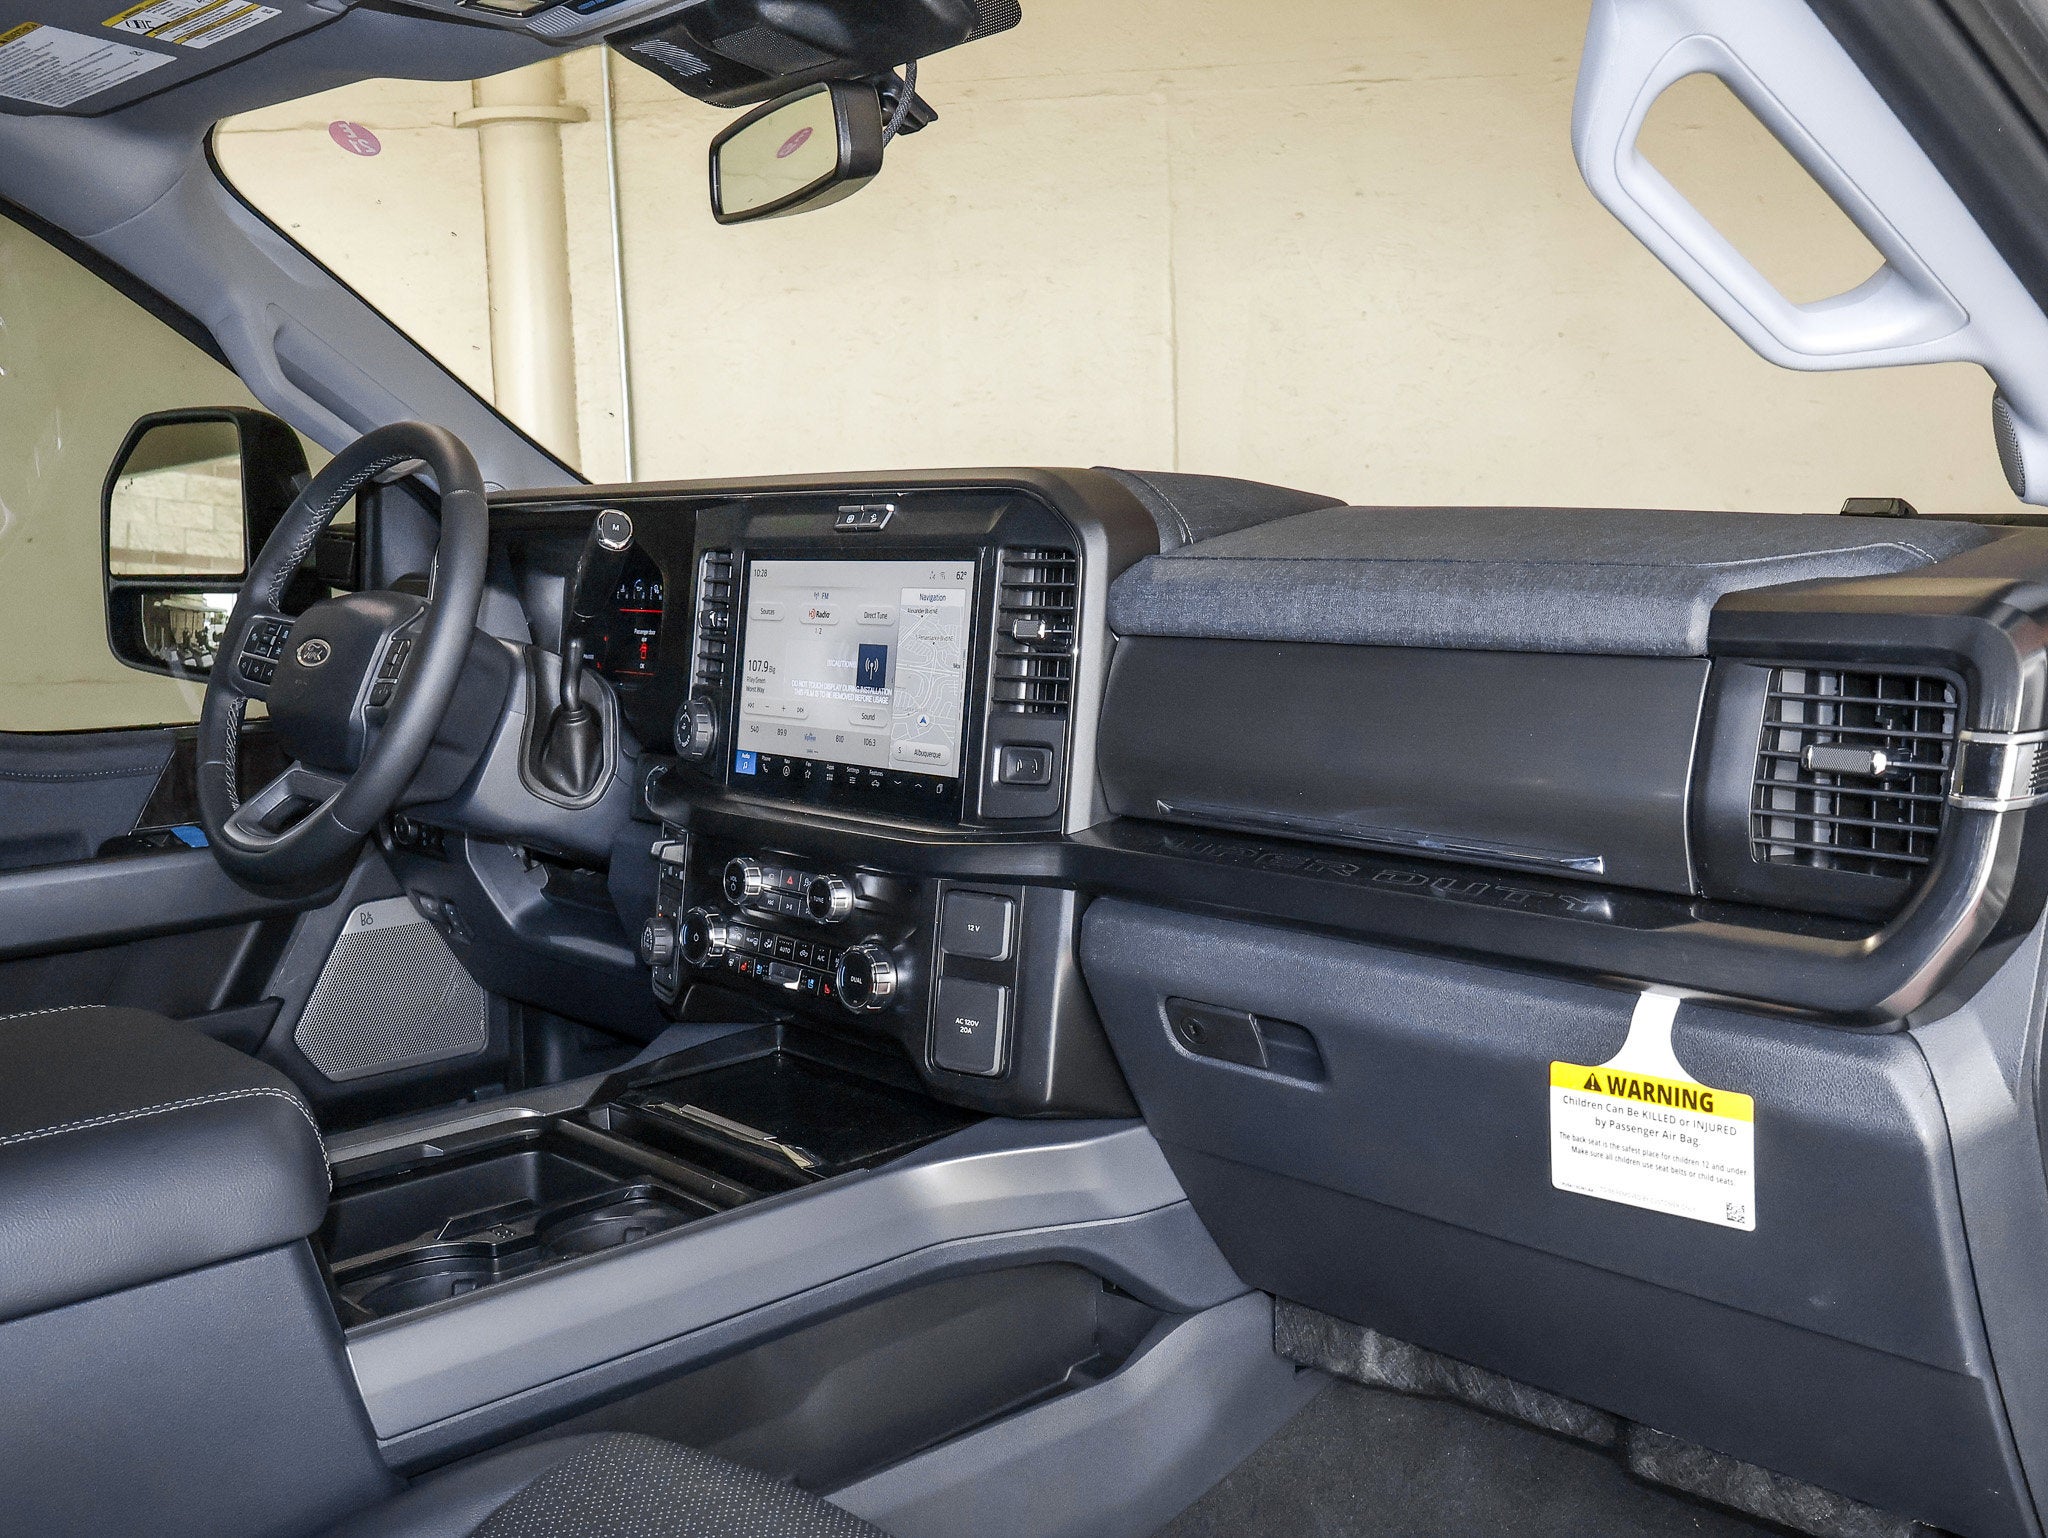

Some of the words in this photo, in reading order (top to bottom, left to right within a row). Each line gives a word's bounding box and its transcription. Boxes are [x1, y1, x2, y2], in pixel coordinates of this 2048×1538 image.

[754, 569, 768, 578] 10:28
[821, 592, 829, 600] FM
[919, 593, 947, 602] Navigation
[760, 607, 775, 616] Sources
[863, 611, 876, 619] Direct
[877, 612, 888, 620] Tune
[748, 659, 769, 673] 107.9
[799, 680, 808, 688] NOT
[809, 681, 824, 690] TOUCH
[824, 682, 842, 692] DISPLAY
[842, 684, 860, 693] DURING
[860, 686, 892, 695] INSTALLATION
[804, 689, 814, 697] FILM
[819, 690, 826, 698] TO
[833, 692, 854, 700] REMOVED
[855, 694, 873, 702] BEFORE
[873, 697, 888, 705] USAGE
[861, 712, 876, 720] Sound
[750, 725, 760, 733] 540
[864, 738, 876, 746] 106.3
[914, 749, 942, 759] Albuquerque
[846, 766, 860, 774] Settings
[967, 924, 975, 932] 12
[779, 946, 791, 954] AUTO
[850, 976, 862, 985] DUAL
[955, 1017, 964, 1025] AC
[964, 1019, 980, 1028] 120V
[960, 1027, 973, 1035] 20A
[1607, 1075, 1713, 1113] WARNING
[1563, 1095, 1603, 1110] Children
[1606, 1103, 1624, 1114] Can
[1627, 1107, 1639, 1117] Be
[1642, 1110, 1676, 1124] KILLED
[1680, 1119, 1689, 1127] or
[1694, 1120, 1736, 1136] INJURED
[1595, 1117, 1607, 1129] by
[1609, 1120, 1659, 1138] Passenger
[1662, 1130, 1676, 1140] Air
[1680, 1133, 1701, 1148] Bag.
[1560, 1131, 1570, 1140] The
[1572, 1134, 1586, 1143] back
[1588, 1138, 1600, 1146] seat
[1610, 1142, 1620, 1150] the
[1622, 1144, 1641, 1155] safest
[1642, 1149, 1659, 1159] place
[1661, 1152, 1670, 1160] for
[1673, 1154, 1700, 1166] children
[1702, 1160, 1710, 1169] 12
[1712, 1163, 1724, 1172] and
[1571, 1146, 1589, 1156] Make
[1590, 1151, 1603, 1159] sure
[1605, 1152, 1613, 1160] all
[1615, 1154, 1640, 1166] children
[1642, 1161, 1653, 1169] use
[1656, 1164, 1669, 1173] seat
[1671, 1166, 1687, 1177] belts
[1689, 1170, 1696, 1178] or
[1698, 1172, 1714, 1182] child
